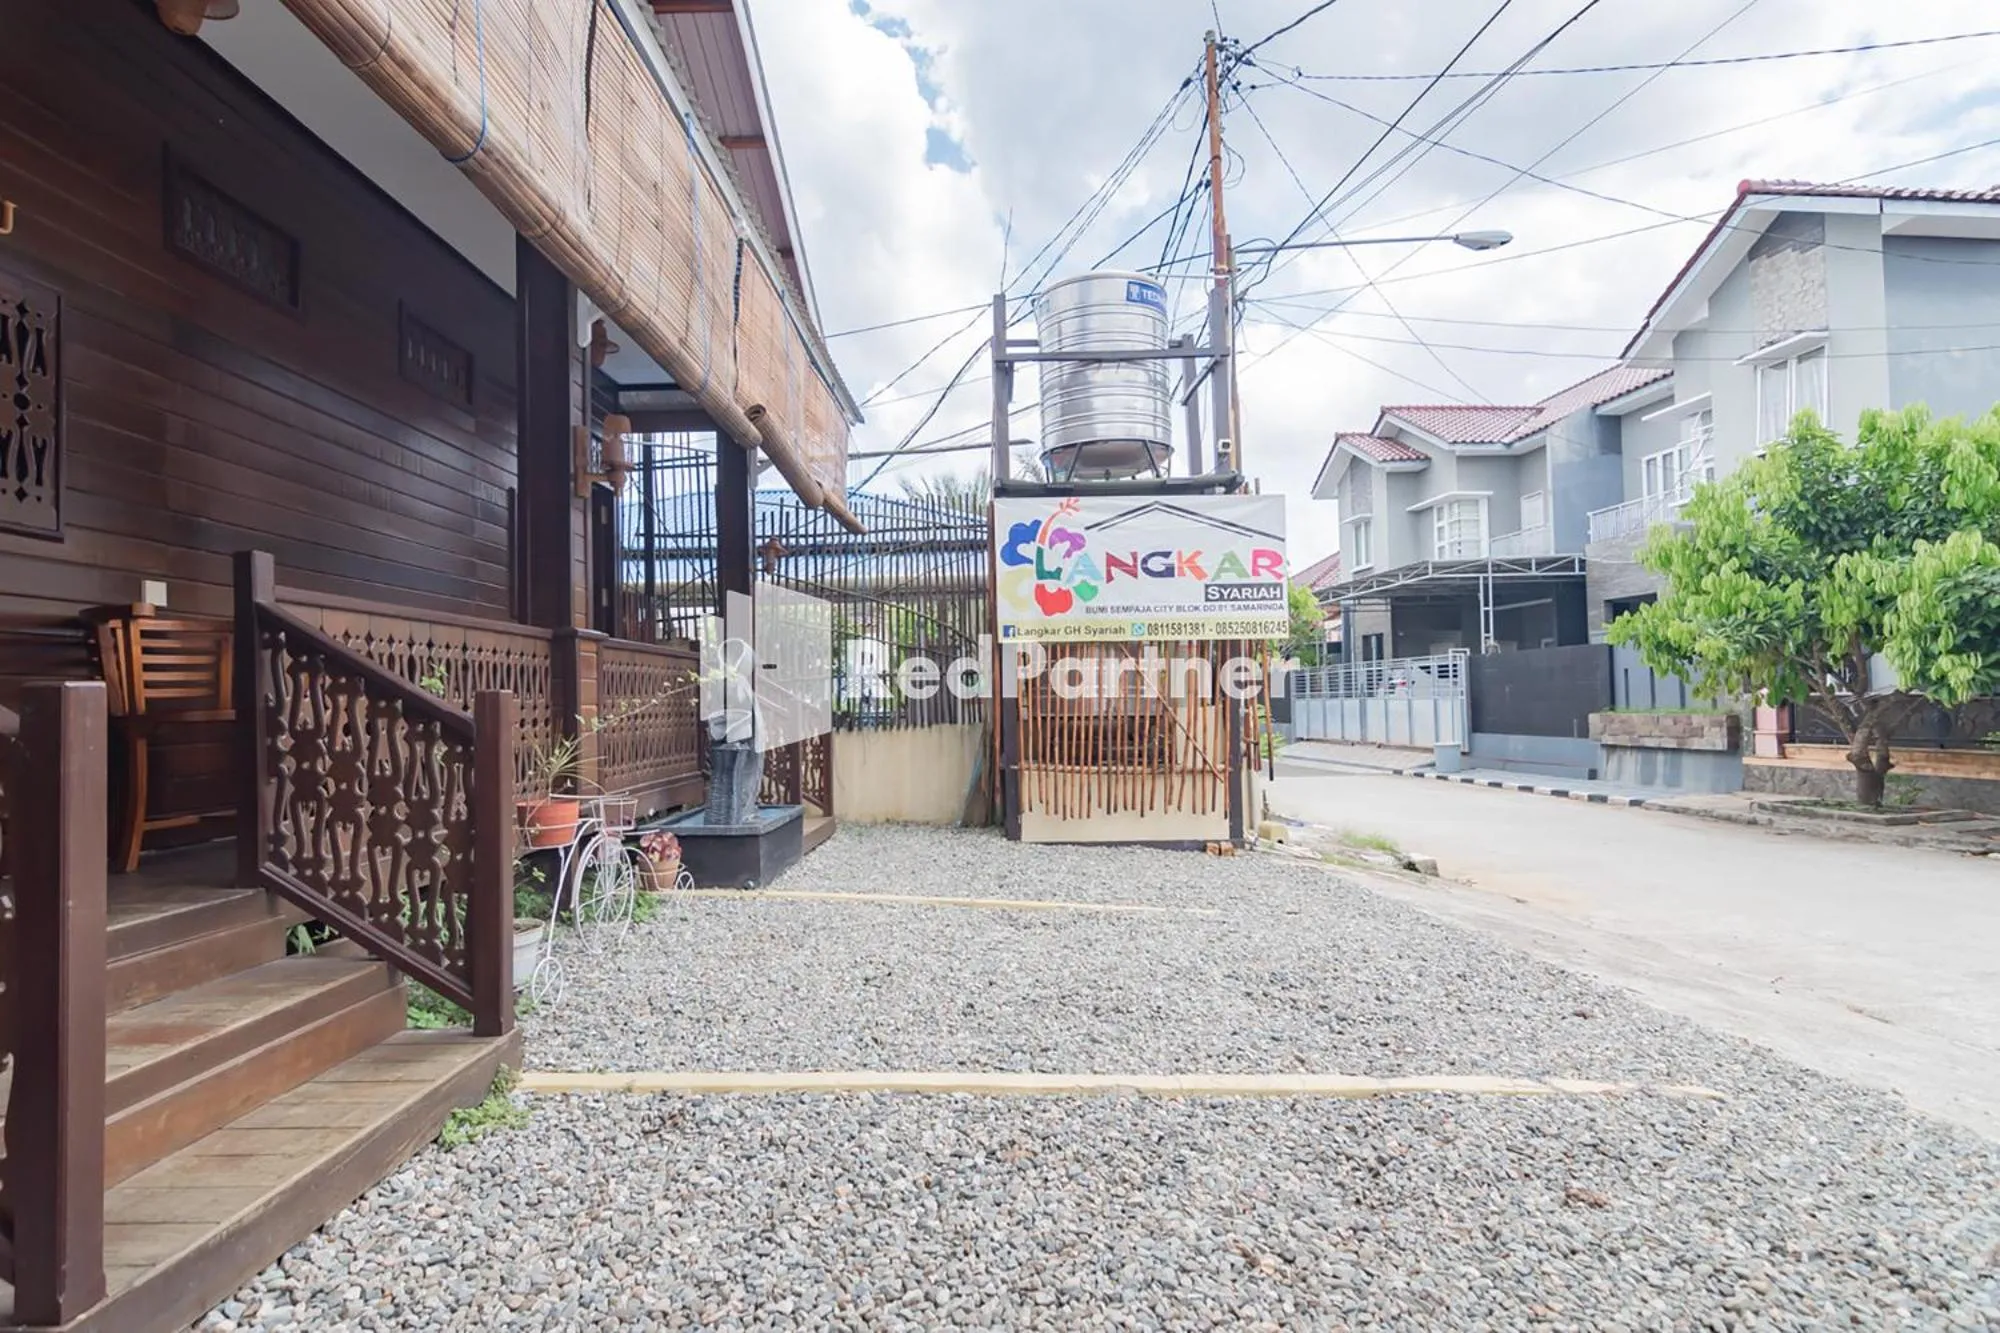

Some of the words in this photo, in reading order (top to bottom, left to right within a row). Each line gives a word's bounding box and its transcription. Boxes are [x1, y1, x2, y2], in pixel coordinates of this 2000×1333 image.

[1036, 546, 1284, 583] LANGKAR
[1207, 586, 1281, 600] SYARIAH
[1085, 605, 1109, 615] BUMI
[1110, 604, 1152, 614] SEMPAJA
[1154, 604, 1175, 613] CITY
[1176, 604, 1201, 613] BLOK
[1231, 602, 1285, 612] SAMARINDA
[1016, 624, 1061, 638] Langkar
[1063, 625, 1081, 636] GH
[1084, 624, 1126, 638] Syariah
[1147, 622, 1206, 637] 0811581381
[1215, 620, 1288, 635] 085250816245
